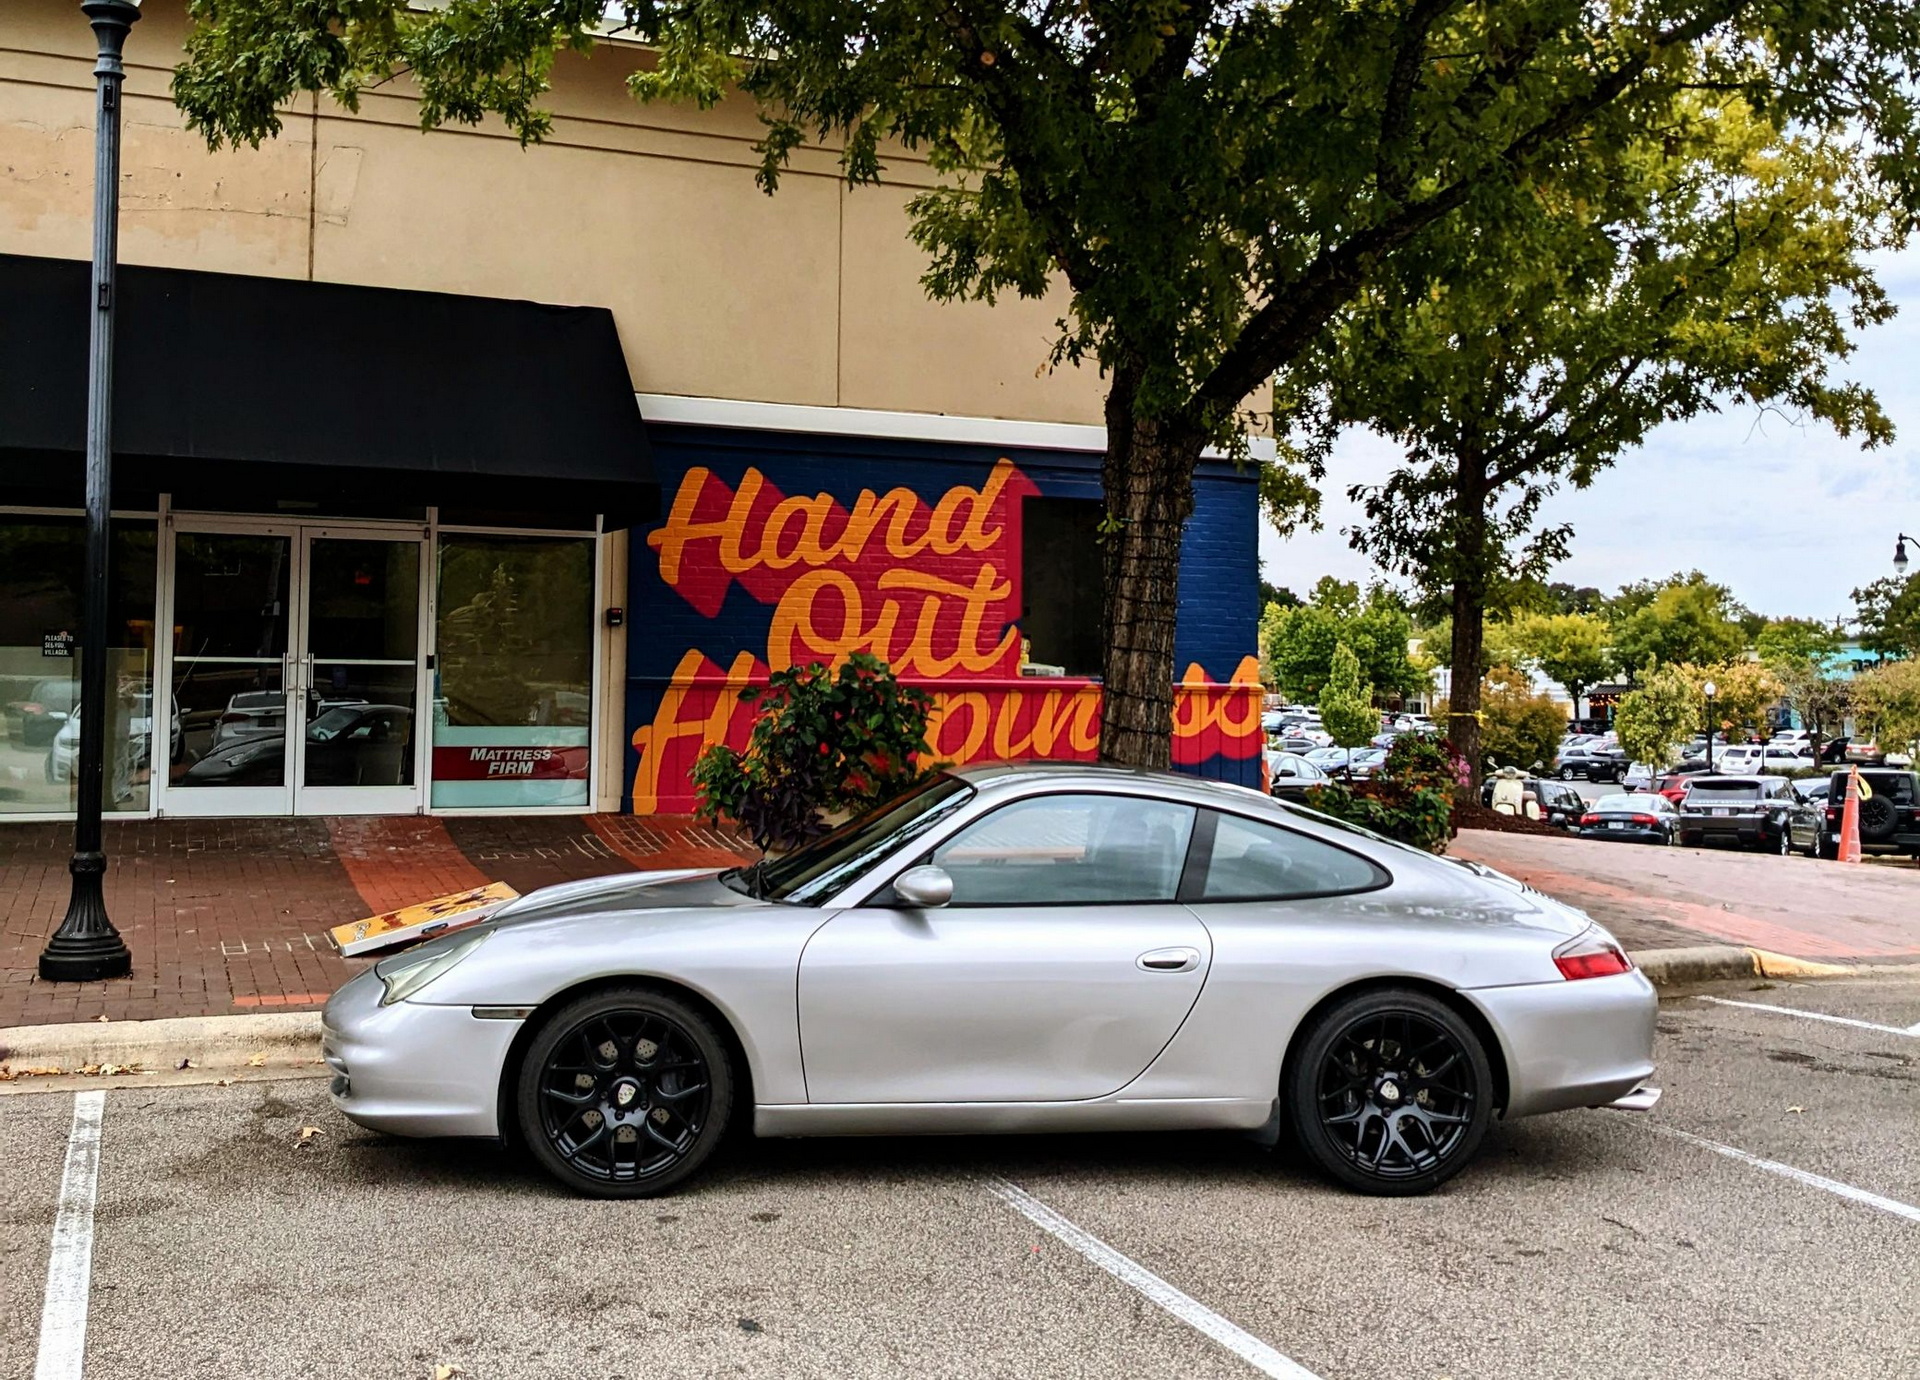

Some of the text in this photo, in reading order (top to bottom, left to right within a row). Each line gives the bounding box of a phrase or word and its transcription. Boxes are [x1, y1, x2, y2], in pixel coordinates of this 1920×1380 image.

[647, 457, 1014, 585] Hand
[767, 564, 1018, 680] Out
[470, 748, 552, 761] MATTRESS
[488, 761, 534, 774] FIRM
